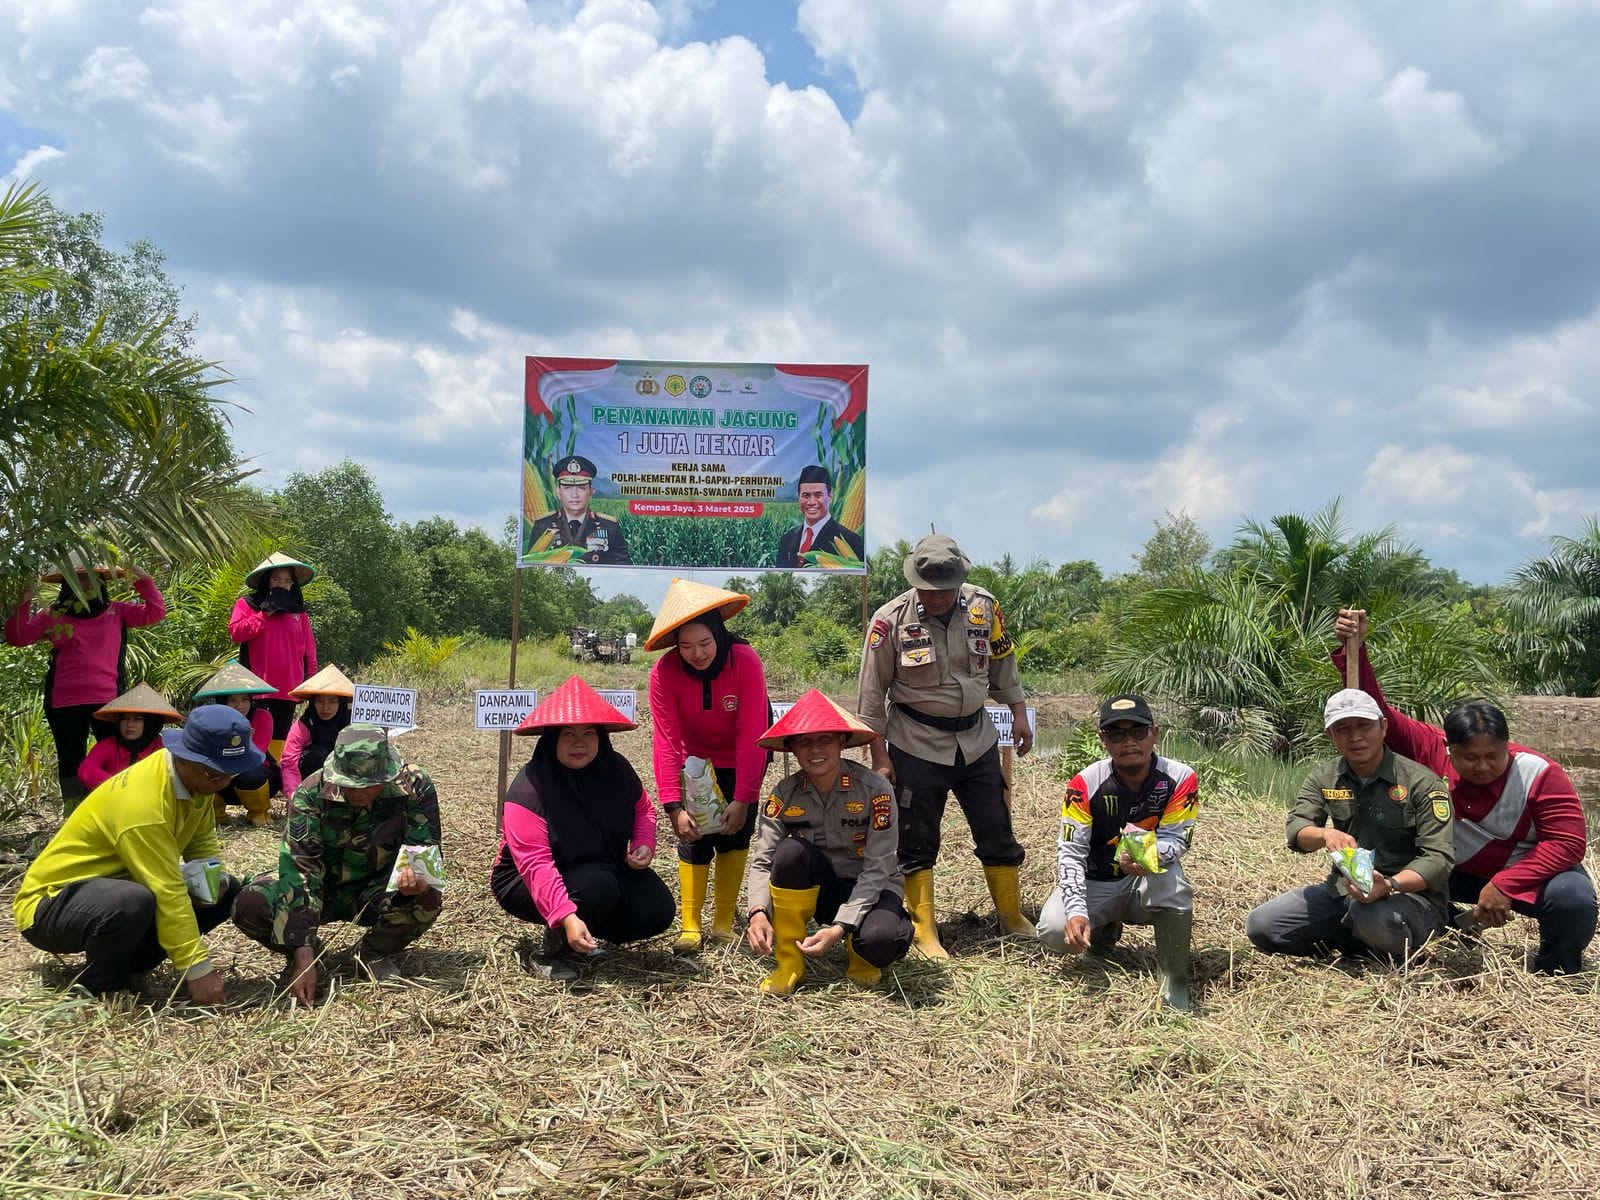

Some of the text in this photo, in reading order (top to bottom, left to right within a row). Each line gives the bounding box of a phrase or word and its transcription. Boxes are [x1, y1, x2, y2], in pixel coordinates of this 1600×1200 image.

[592, 406, 798, 429] PENANAMAN JAGUNG
[618, 432, 776, 456] 1 JUTA HEKTAR
[671, 463, 726, 473] KERJA SAMA
[611, 474, 687, 484] POLRI-KEMENTAN
[620, 486, 775, 498] INHUTANI-SWASTA-SWADAYA PETANI
[634, 503, 671, 513] Kempas
[672, 504, 696, 513] Jaya,
[704, 505, 732, 513] Maret
[733, 505, 755, 514] 2025
[359, 689, 411, 706] KOORDINATOR
[479, 695, 533, 708] DANRAMIL
[354, 707, 411, 725] PP BPP KEMPAS
